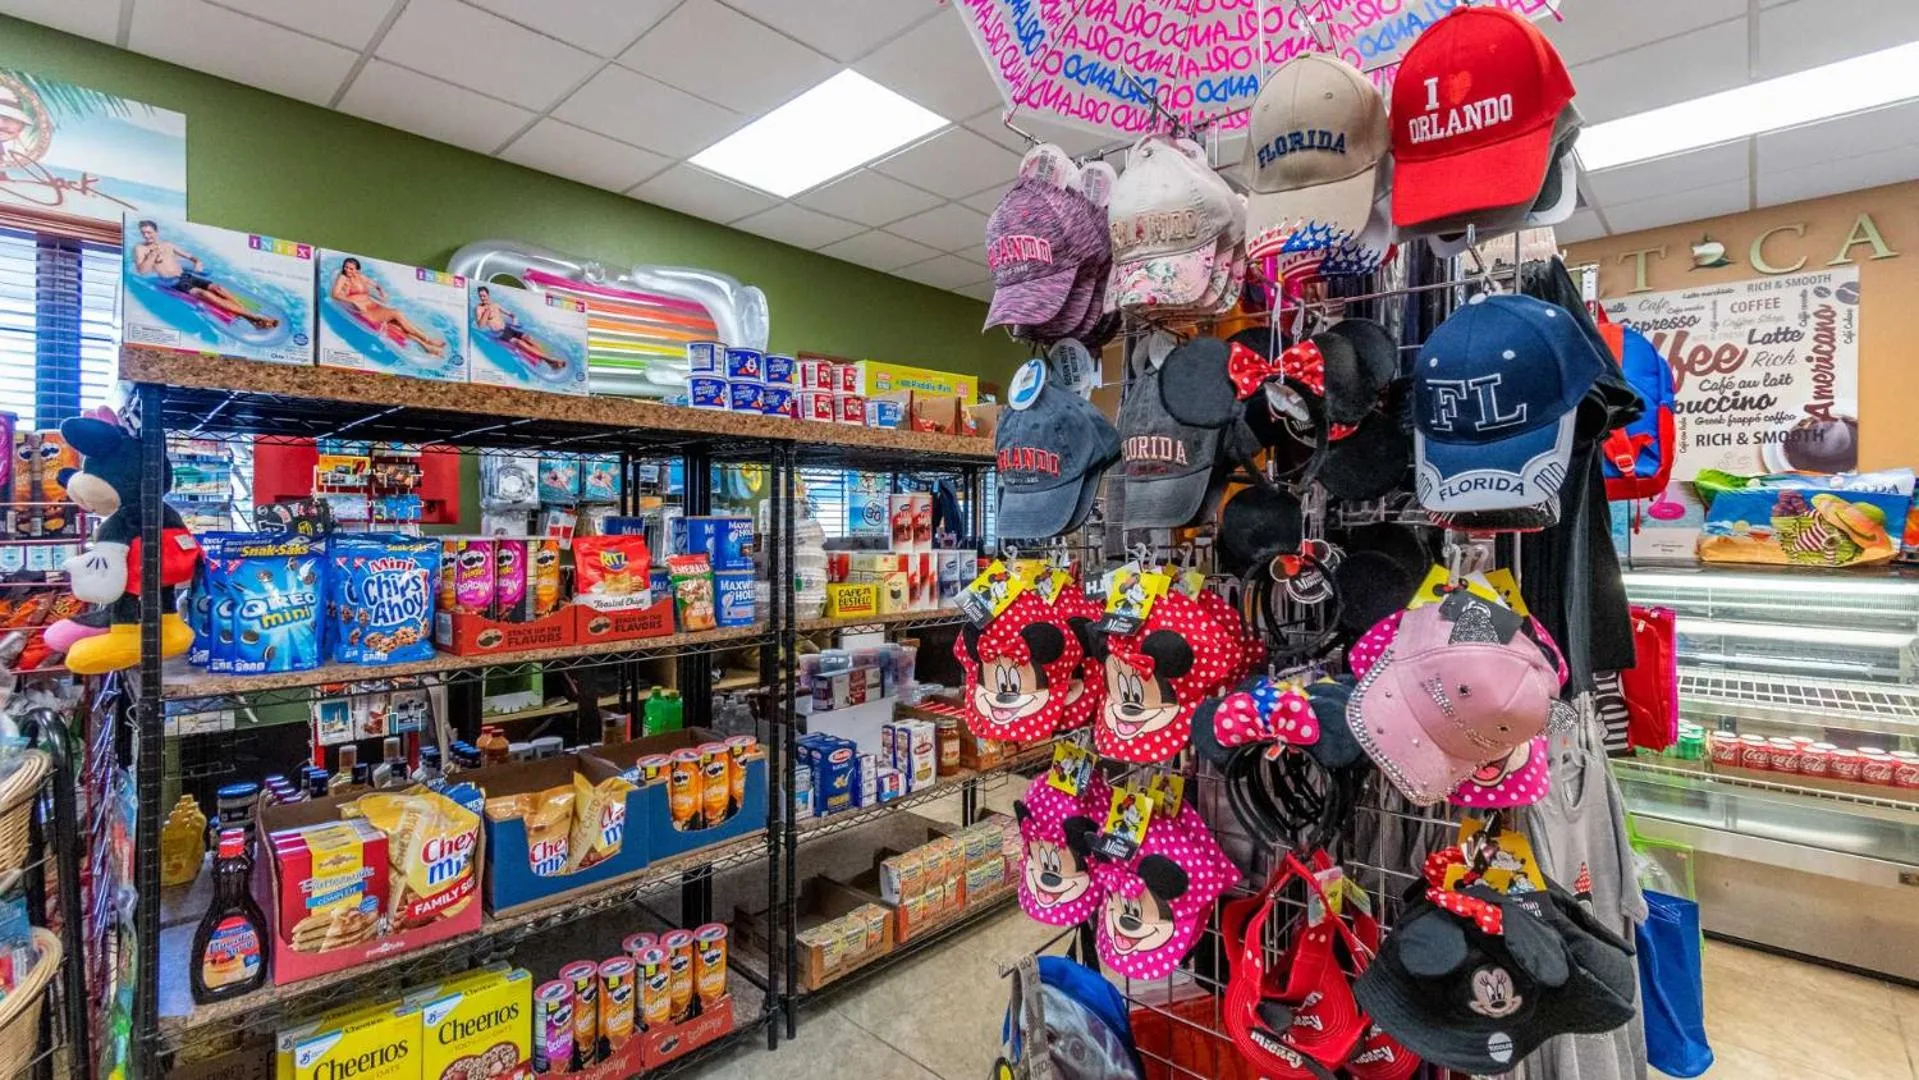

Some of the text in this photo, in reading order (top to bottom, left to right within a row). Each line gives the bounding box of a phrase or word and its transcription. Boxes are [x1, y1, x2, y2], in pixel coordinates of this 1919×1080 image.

[1424, 76, 1440, 111] I
[1408, 94, 1514, 144] ORLANDO
[1256, 128, 1347, 169] FLORIDA
[1746, 273, 1833, 293] RICH & SMOOTH
[1729, 296, 1782, 314] COFFEE
[1747, 326, 1805, 346] Latte
[1751, 348, 1797, 368] Rich
[1804, 302, 1839, 422] Americano
[1698, 371, 1794, 395] Café au lait
[1425, 373, 1528, 432] FL
[1695, 427, 1825, 447] RICH & SMOOTH
[1439, 477, 1525, 501] FLORIDA
[369, 557, 414, 574] Mini
[240, 592, 317, 618] OREO
[260, 606, 313, 629] mini
[615, 619, 662, 634] FLAVORS
[507, 632, 562, 647] FLAVORS
[421, 826, 478, 864] Chex
[414, 887, 461, 915] FAMILY
[438, 1001, 520, 1046] Cheerios
[312, 1039, 409, 1080] Cheerios
